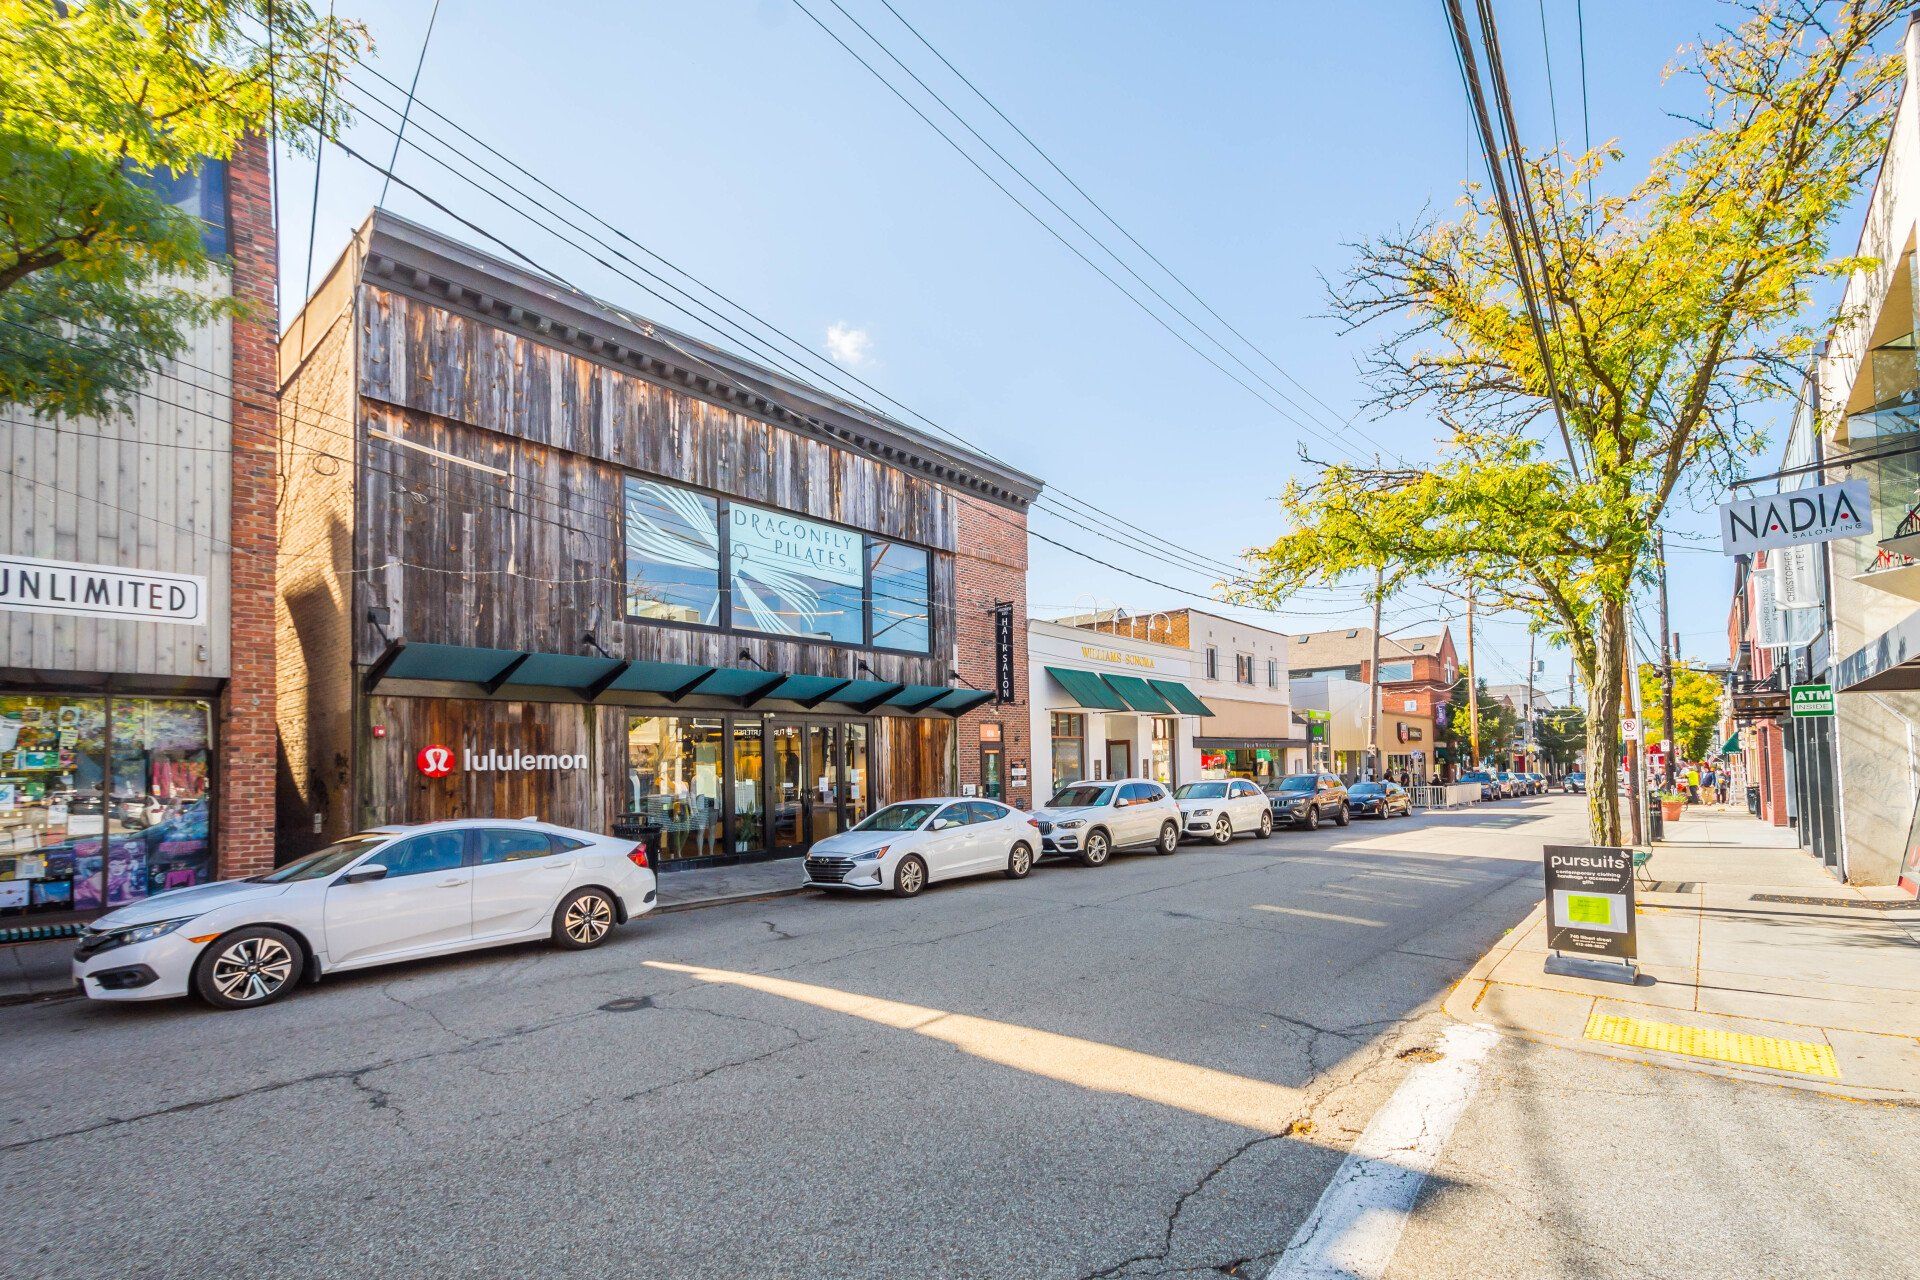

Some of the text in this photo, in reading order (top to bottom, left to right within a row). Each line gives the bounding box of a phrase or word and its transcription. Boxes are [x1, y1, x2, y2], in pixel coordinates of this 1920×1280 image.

[734, 509, 852, 549] DRAGONFLY
[1729, 489, 1861, 543] NADIA
[1792, 527, 1833, 539] SALON
[775, 539, 846, 571] PILATES
[1796, 547, 1805, 571] ATEL
[1784, 551, 1796, 603] CHRISTOPHER
[1001, 617, 1009, 652] HAIR
[1002, 654, 1010, 698] SALON
[1794, 690, 1831, 701] ATM
[463, 748, 588, 772] lululemon
[1551, 855, 1625, 869] pursuits
